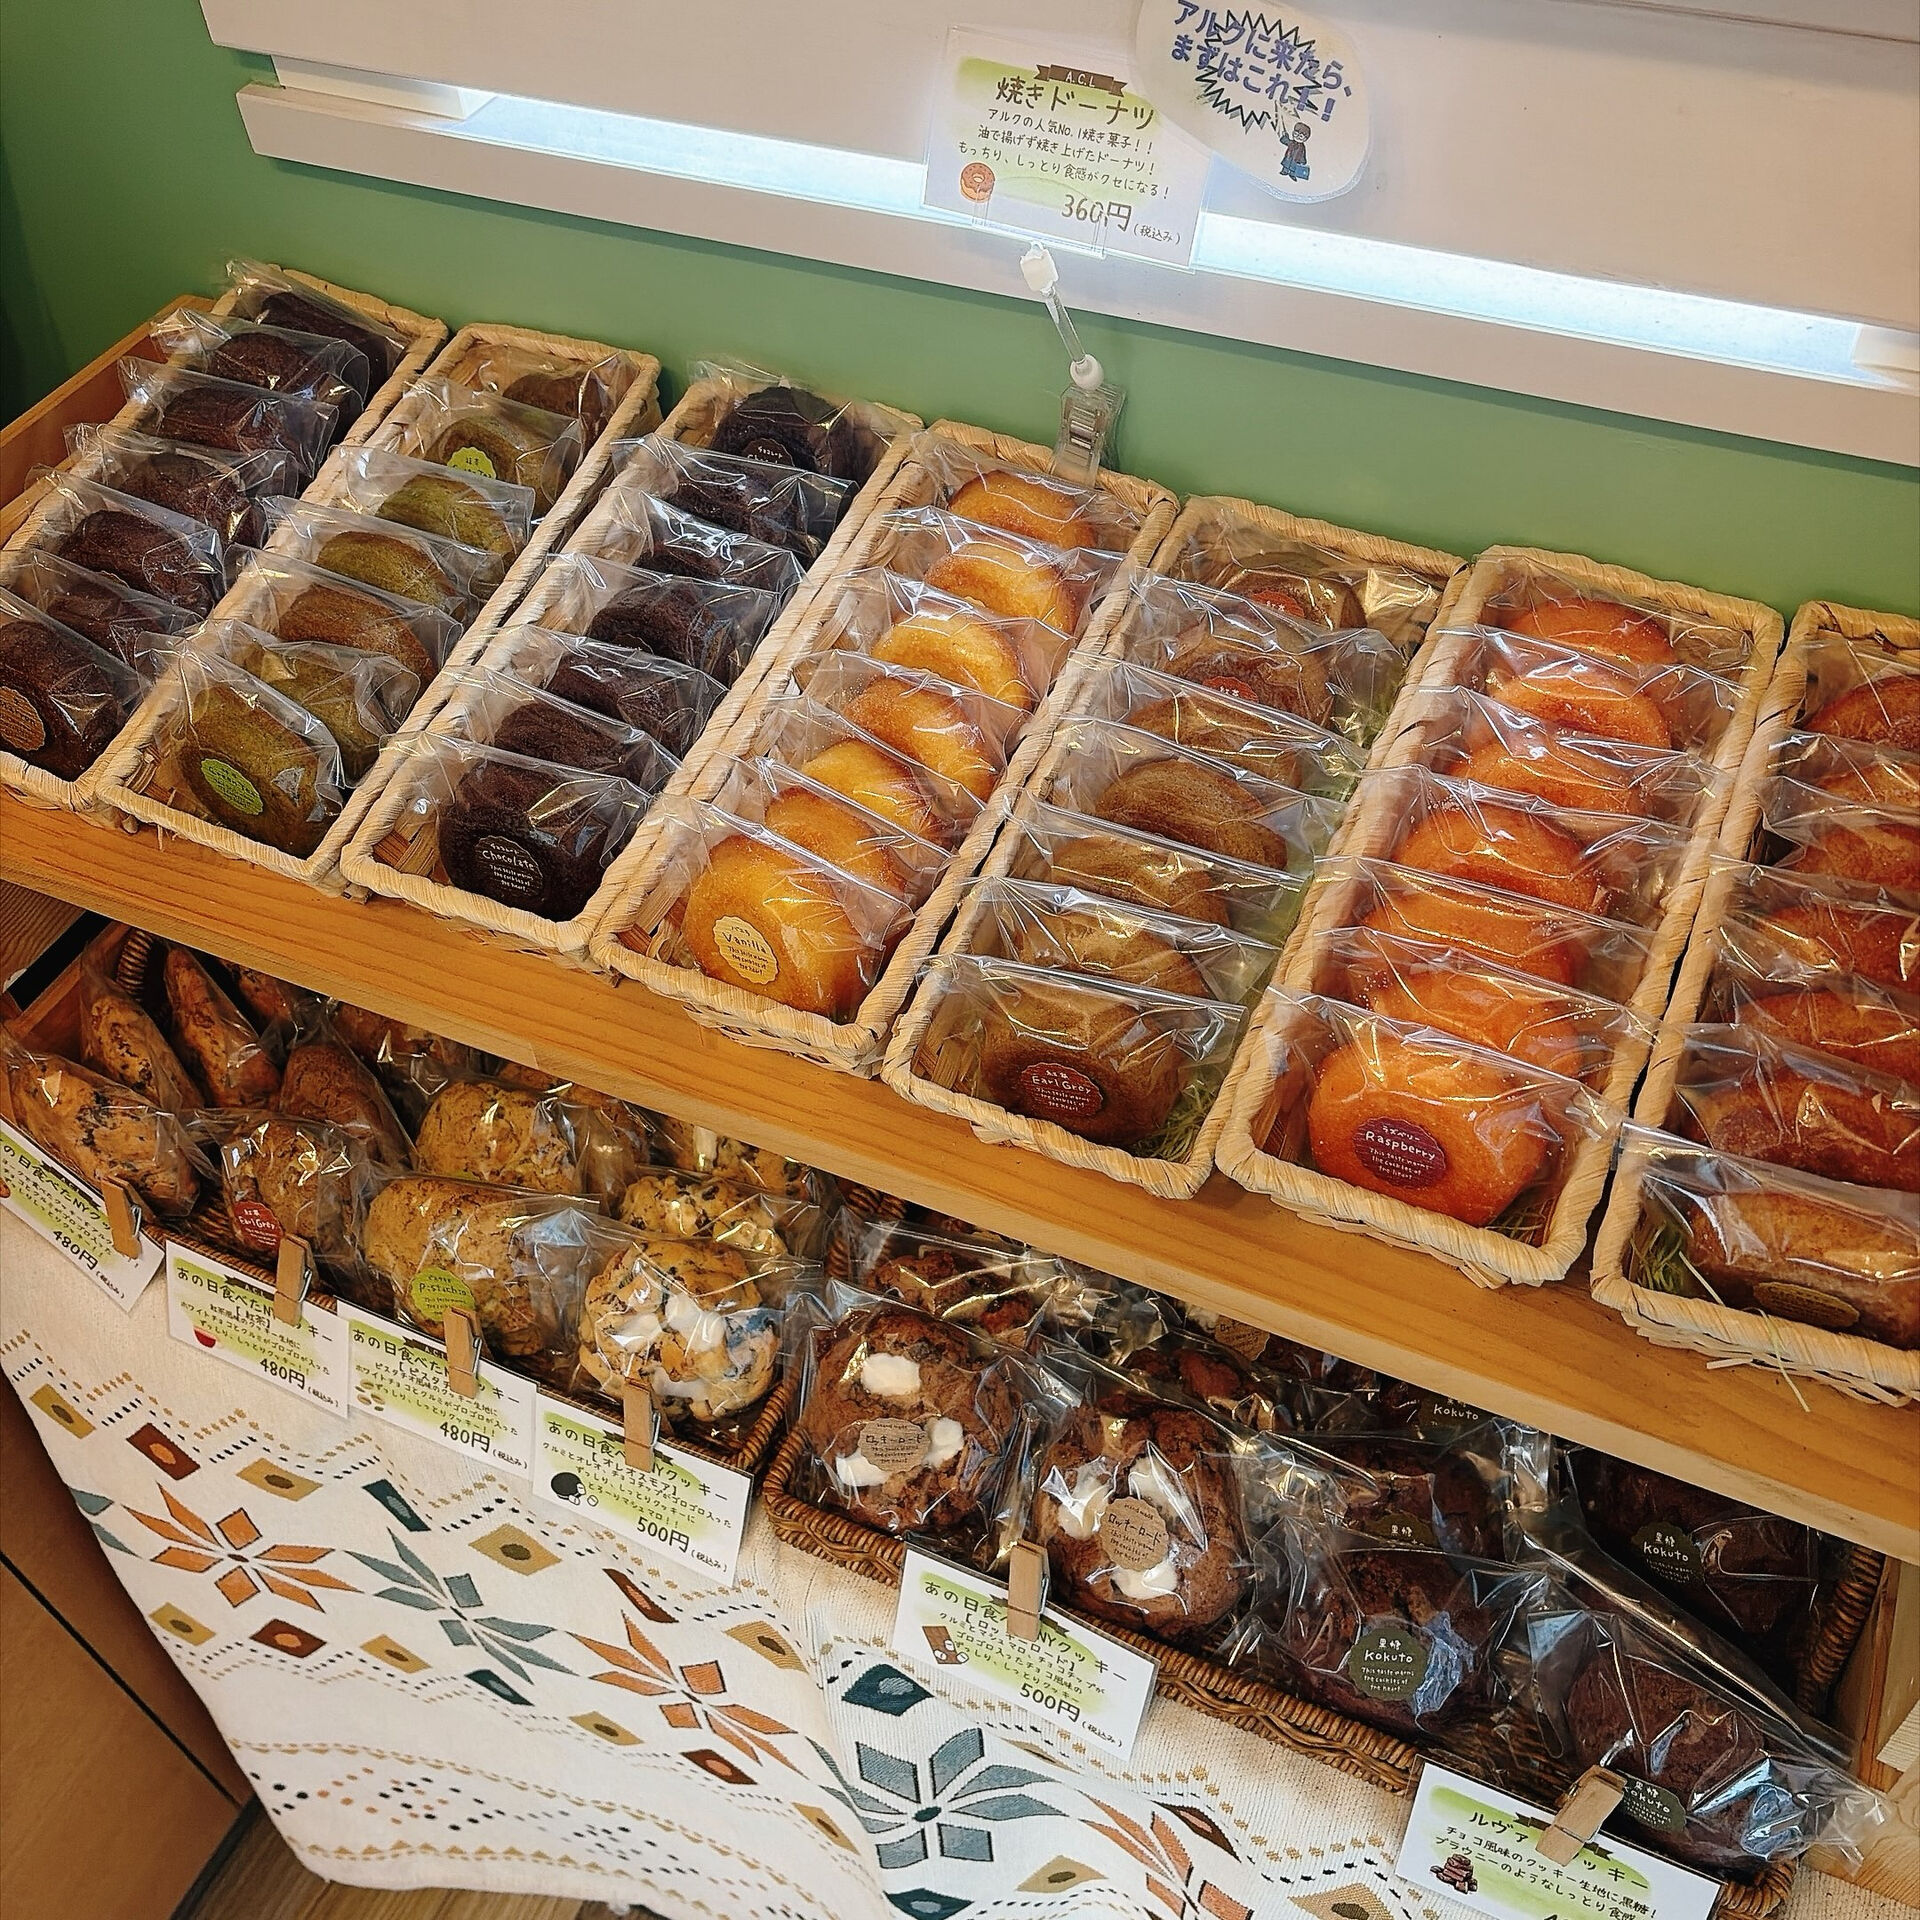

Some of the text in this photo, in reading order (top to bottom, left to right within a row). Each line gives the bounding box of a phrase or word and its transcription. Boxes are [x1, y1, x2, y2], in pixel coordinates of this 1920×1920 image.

[1174, 0, 1352, 97] アルクに来たら、
[1171, 34, 1336, 121] まずはこれ！！
[996, 76, 1155, 130] 焼きドーナツ
[978, 125, 1156, 175] 油で揚げず焼き上げたドーナツ！
[959, 141, 1169, 200] もっちり、しっとり食感がクセになる！
[1062, 194, 1132, 232] 360円
[482, 850, 534, 871] Chocolate
[722, 932, 766, 954] Vanilla
[1032, 1076, 1060, 1087] Earl
[1365, 1130, 1436, 1160] Raspberry
[53, 1230, 98, 1270] 480円
[260, 1359, 305, 1390] 480円
[1434, 1404, 1479, 1420] Kokuto
[440, 1422, 490, 1453] 480円
[637, 1517, 689, 1553] 500円
[1108, 1513, 1166, 1546] ロッキーロード
[1643, 1541, 1689, 1561] Kokuto
[1364, 1650, 1413, 1663] Kokuto
[1019, 1683, 1080, 1722] 500円
[1470, 1812, 1648, 1890] ルヴァッキー
[1446, 1826, 1657, 1919] チョコ風味のクッキー生地に黒糖！
